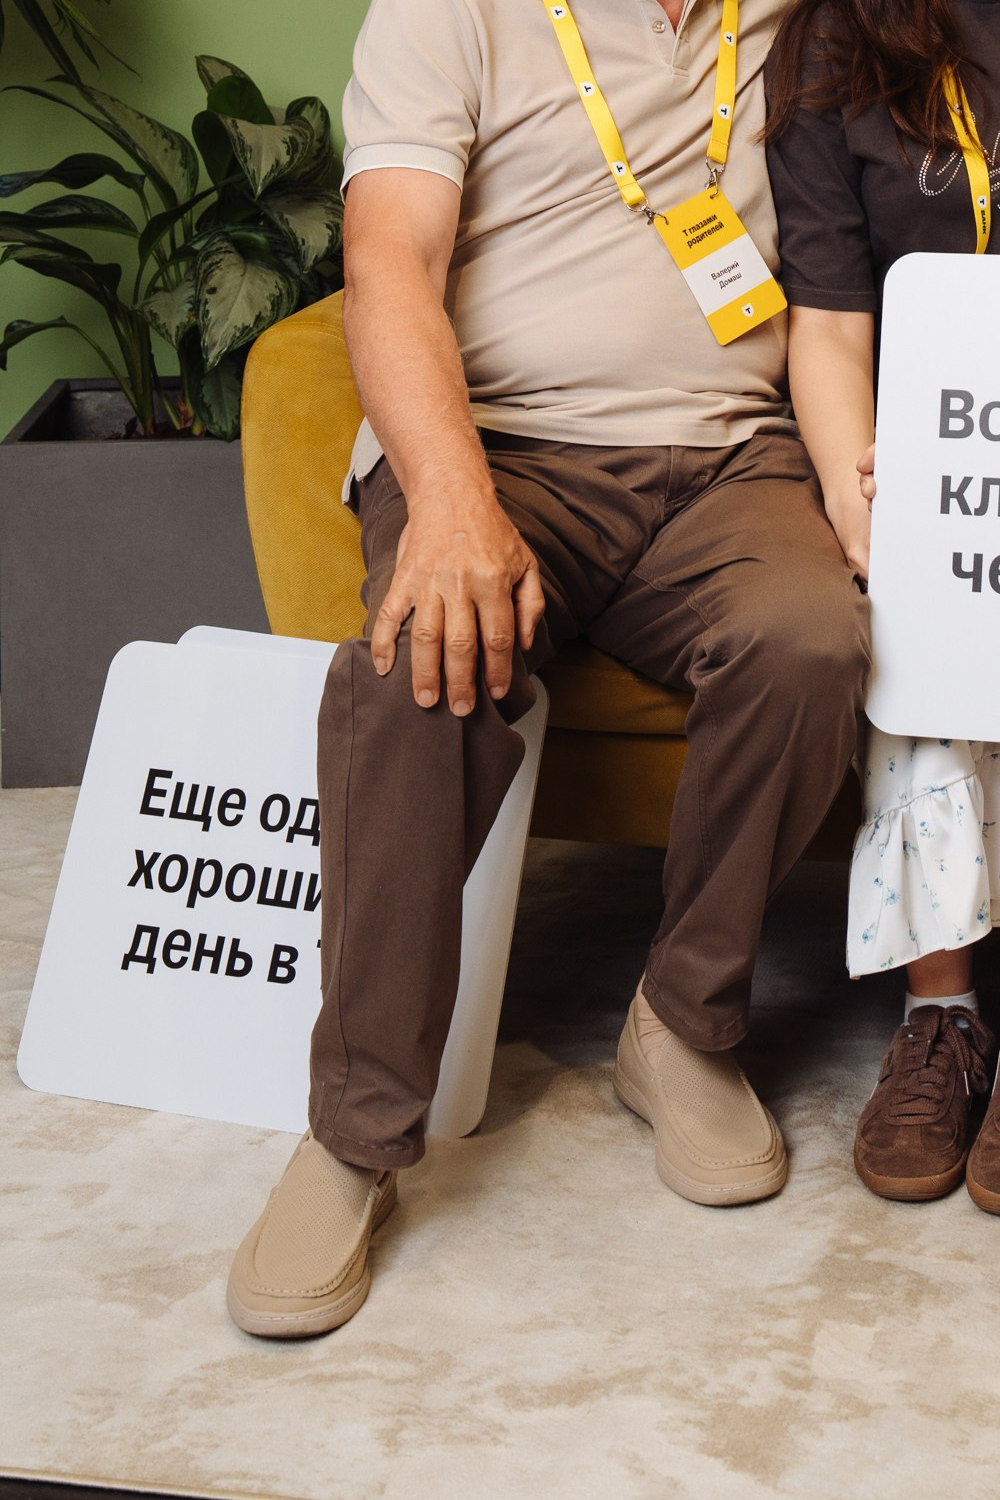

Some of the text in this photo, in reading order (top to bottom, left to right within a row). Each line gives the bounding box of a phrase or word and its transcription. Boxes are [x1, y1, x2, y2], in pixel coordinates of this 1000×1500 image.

[687, 221, 725, 248] родителей
[689, 214, 718, 234] глазами
[711, 261, 740, 280] Валерий
[719, 273, 742, 289] Домаш
[139, 767, 321, 847] Еще од
[121, 924, 299, 985] день в
